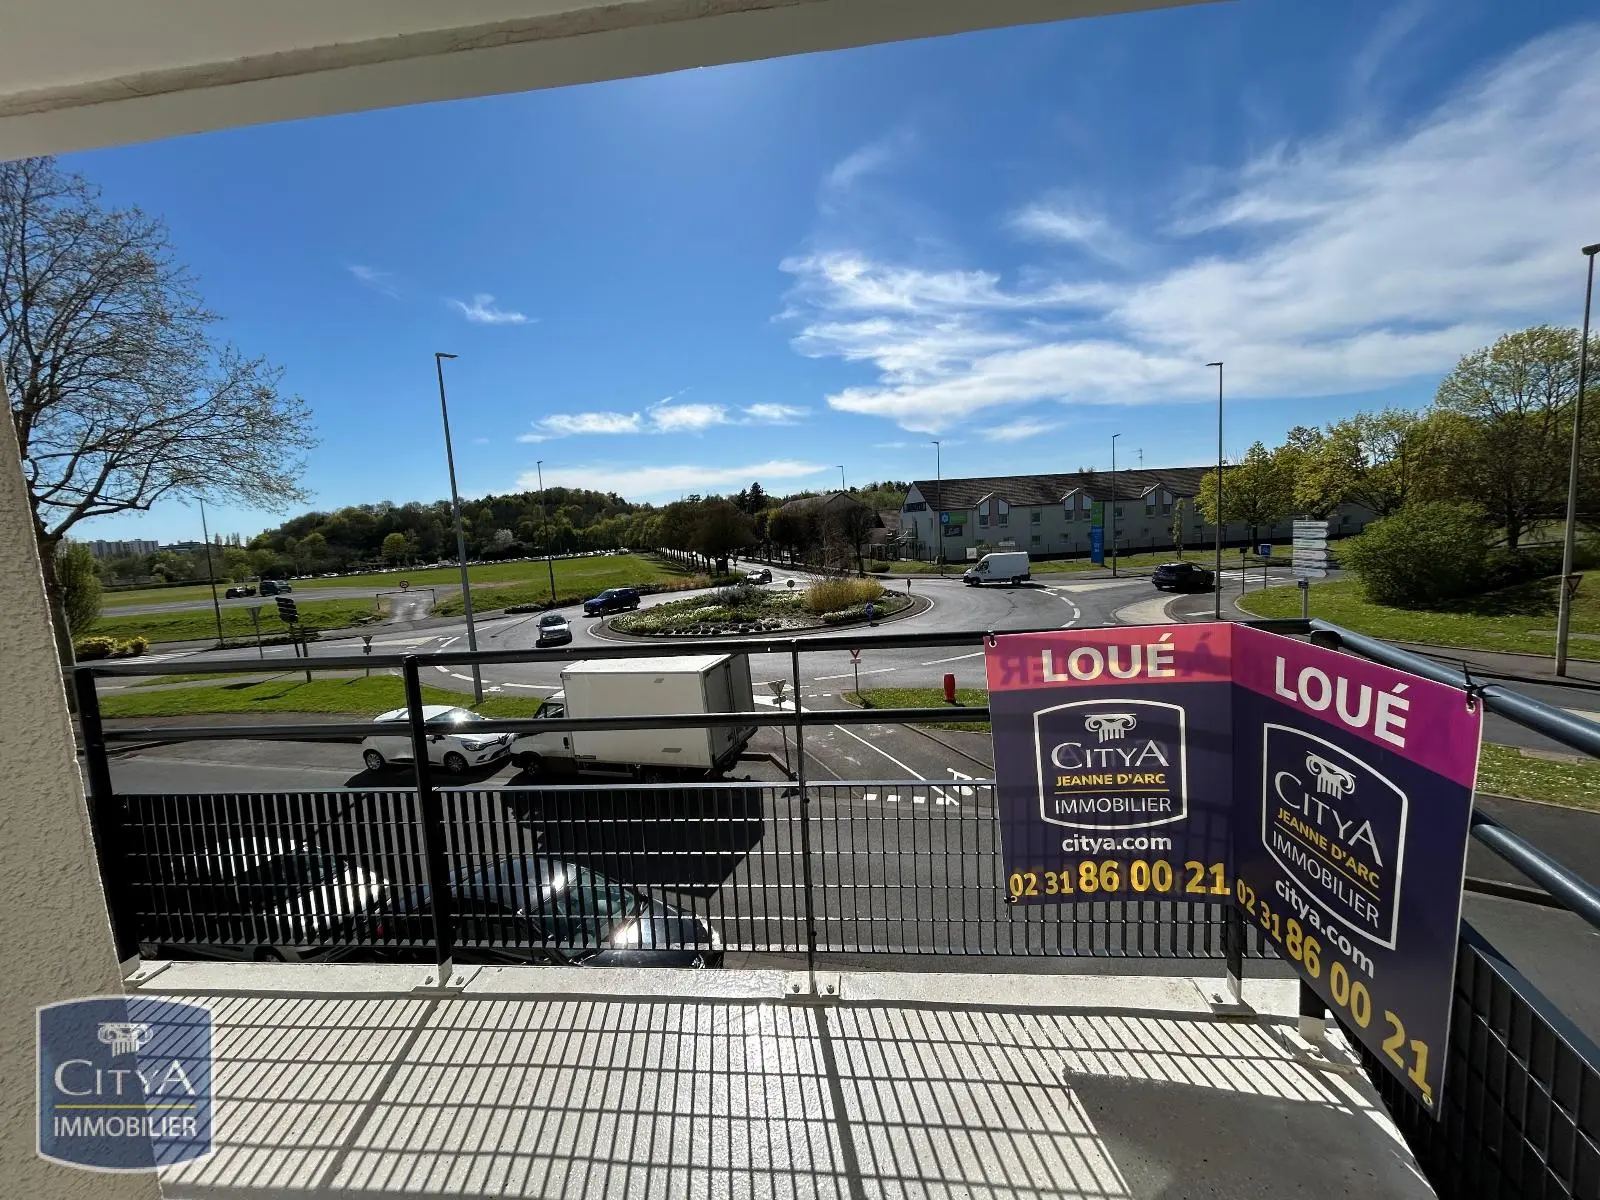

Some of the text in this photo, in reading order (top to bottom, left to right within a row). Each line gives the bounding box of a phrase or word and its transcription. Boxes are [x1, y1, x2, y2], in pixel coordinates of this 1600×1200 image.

[1041, 632, 1176, 683] LOUÉ
[1275, 655, 1410, 749] LOUÉ
[1050, 740, 1170, 769] CITYA
[1056, 773, 1166, 787] JEANNE D'ARC
[1055, 797, 1172, 815] IMMOBILIER
[1274, 771, 1384, 868] CITYA
[1061, 834, 1172, 855] citya.com
[1277, 807, 1380, 889] JEANNE D'ARC
[1009, 859, 1231, 897] 02 31 86 00 21
[1273, 830, 1379, 929] IMMOBILIER
[1275, 879, 1374, 979] citya.com
[1236, 878, 1433, 1097] 02 31 86 00 21
